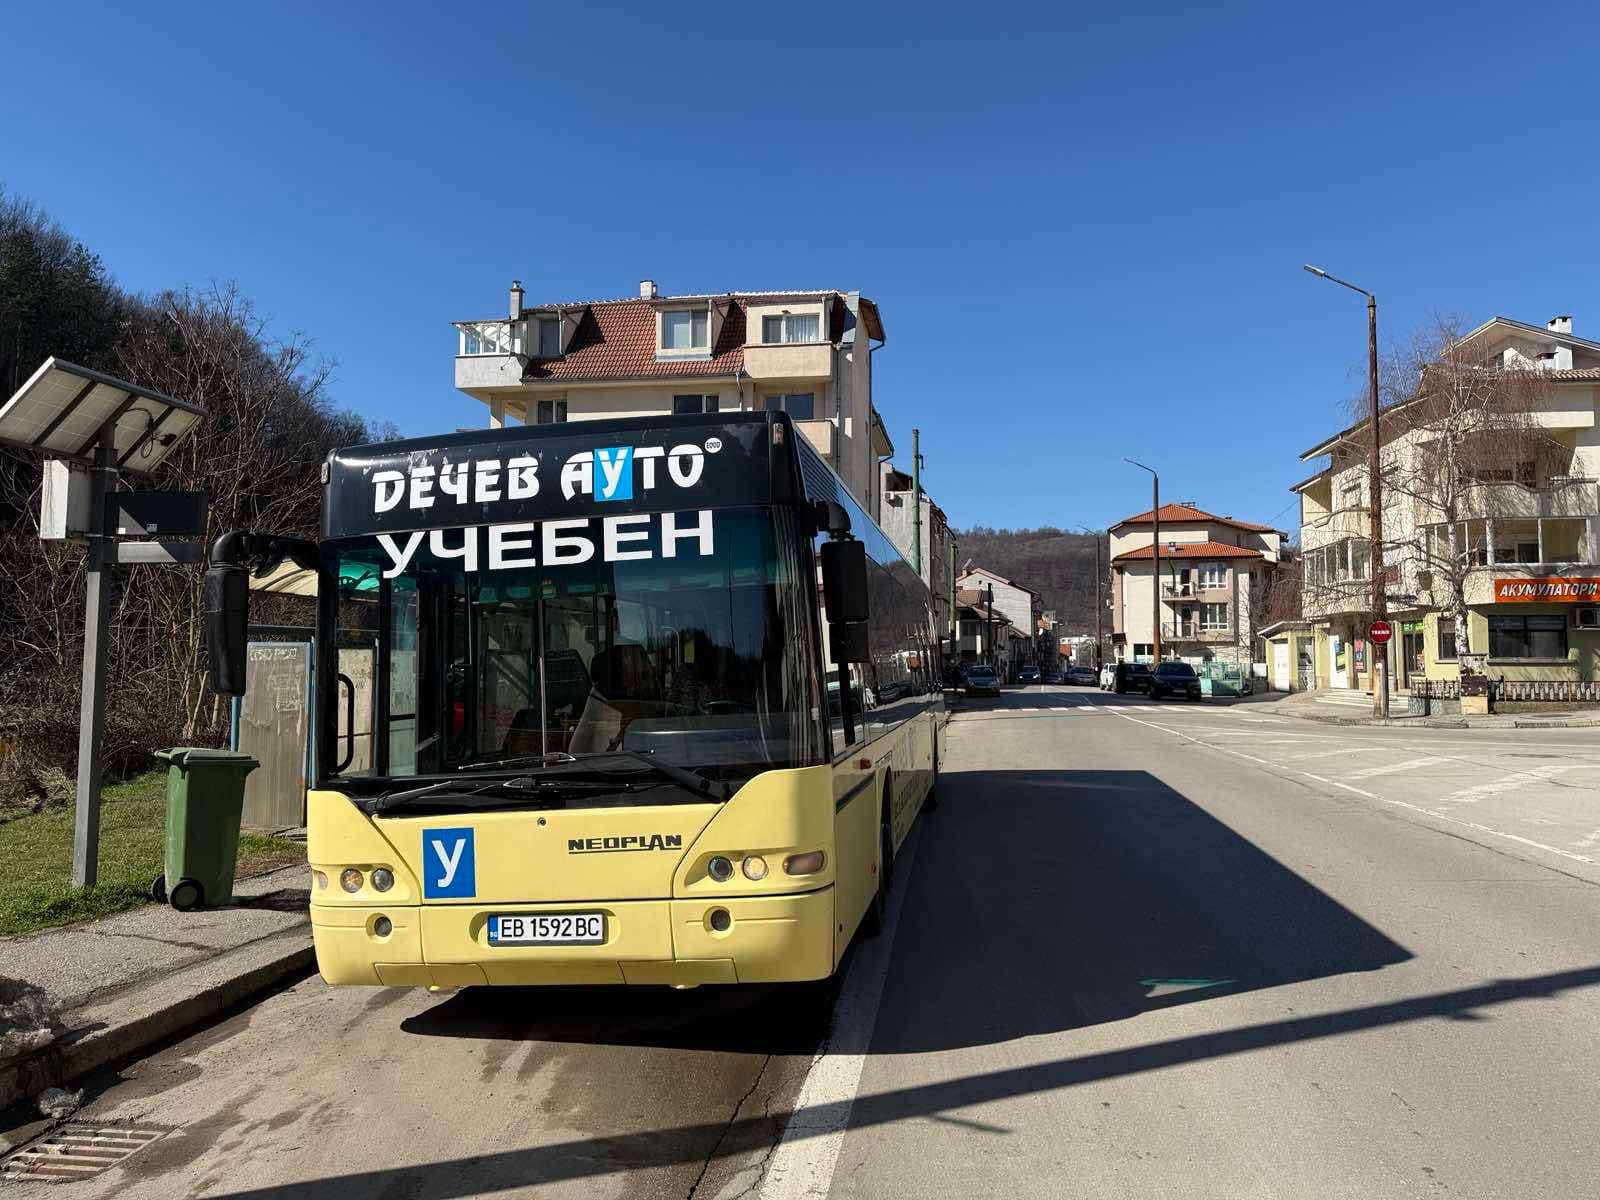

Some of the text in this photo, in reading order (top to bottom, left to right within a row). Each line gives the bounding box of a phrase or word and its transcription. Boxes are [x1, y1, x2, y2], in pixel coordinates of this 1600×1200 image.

[376, 510, 714, 579] УЧЕБЕН
[1500, 583, 1598, 597] АКУМУЛАТОРИ
[568, 834, 682, 852] NEOPLAN
